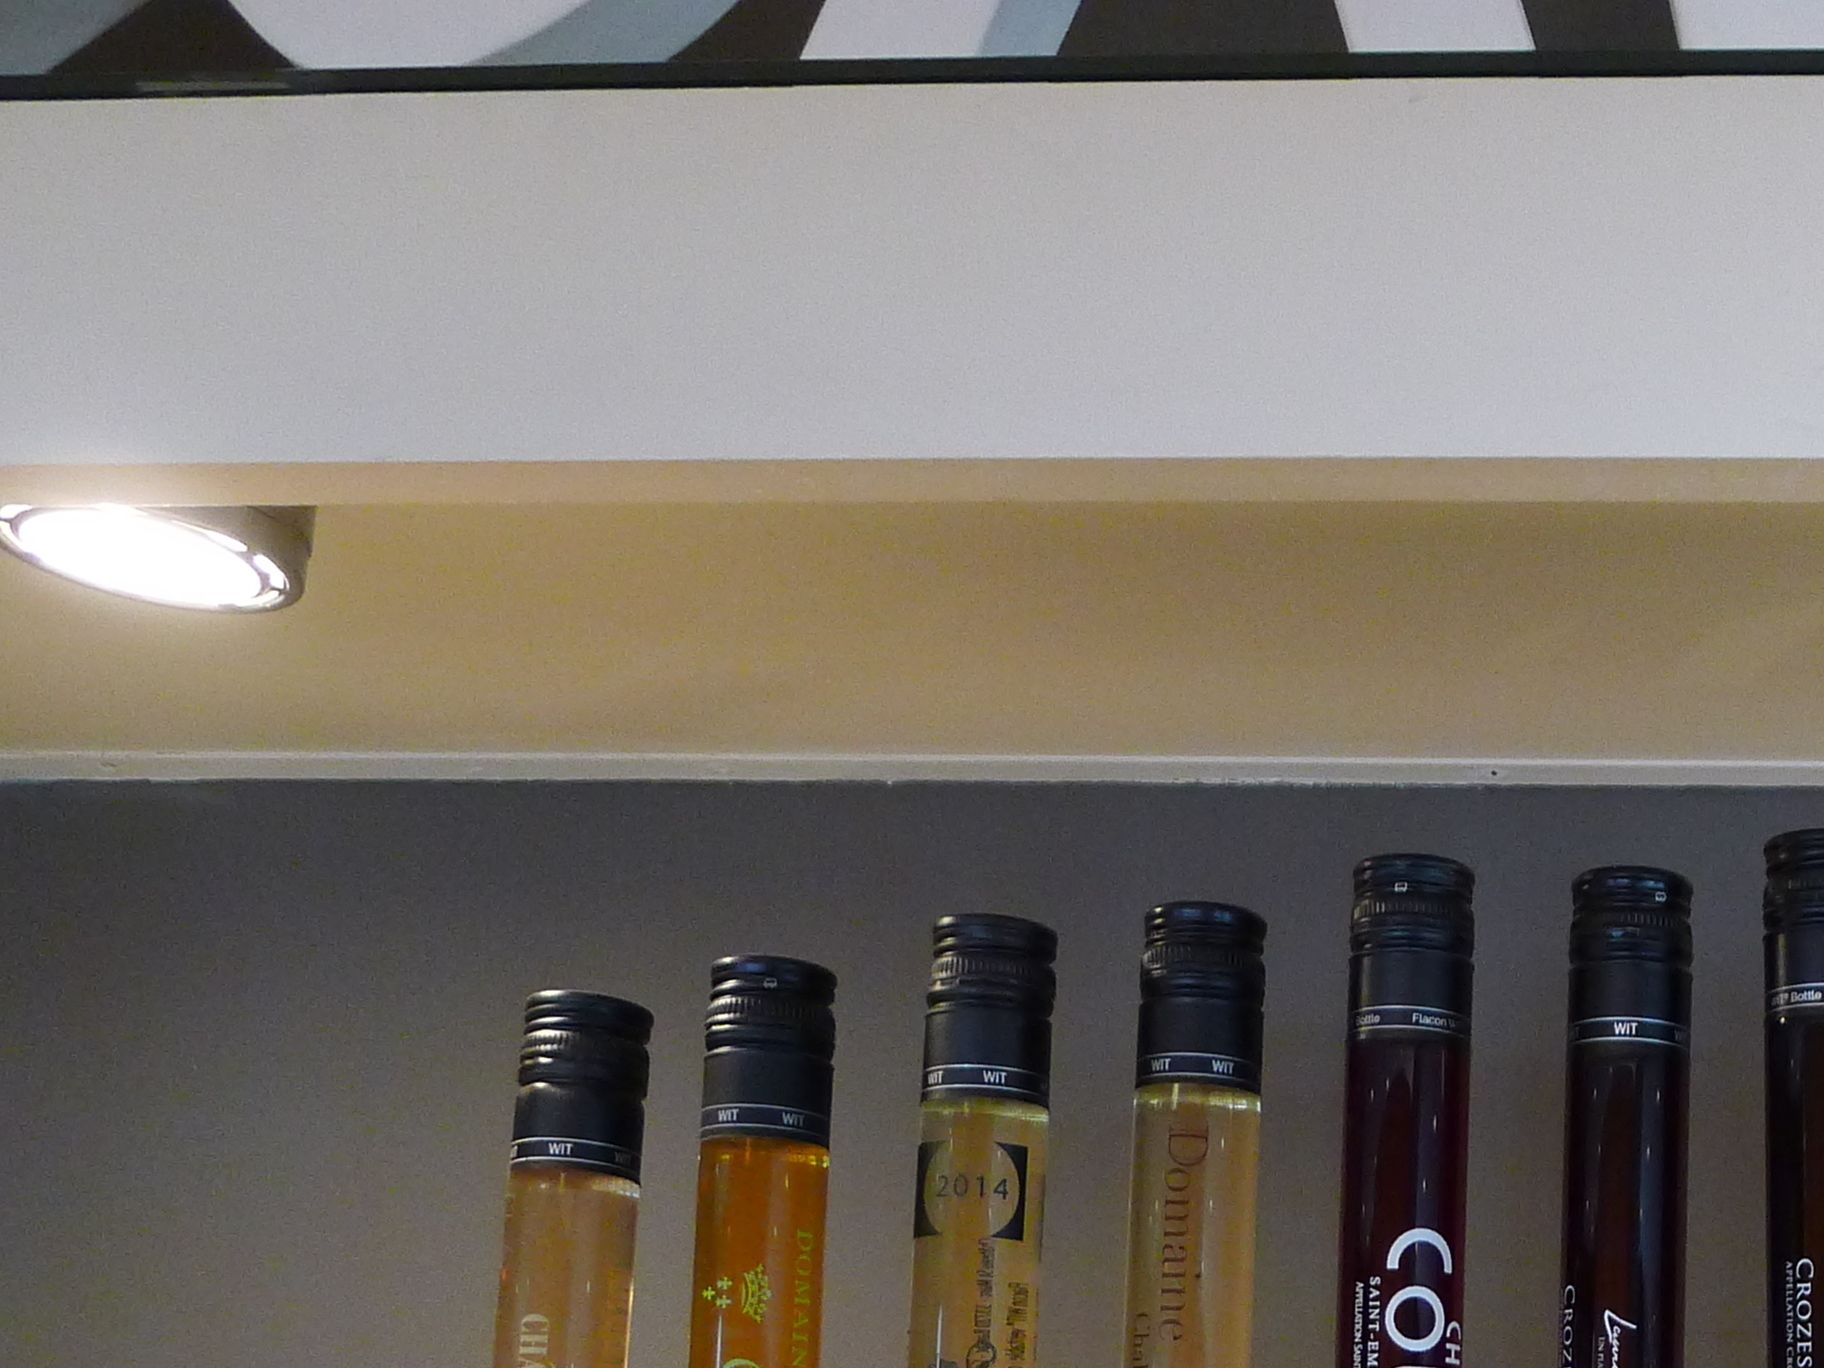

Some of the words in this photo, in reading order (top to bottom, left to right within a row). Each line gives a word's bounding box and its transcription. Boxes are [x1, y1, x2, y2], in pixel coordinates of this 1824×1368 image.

[1412, 1012, 1448, 1027] Flacon
[1614, 1022, 1638, 1036] WIT
[1151, 1058, 1171, 1071] WIT
[1212, 1060, 1234, 1074] WIT
[983, 1070, 1007, 1084] WIT
[718, 1108, 739, 1121] WIT
[782, 1111, 806, 1126] WIT
[549, 1142, 574, 1155] WIT
[936, 1174, 1008, 1200] 2014
[1158, 1123, 1209, 1342] Domaine
[1784, 1261, 1794, 1343] APPELLATION
[1352, 1281, 1365, 1344] APPELLATION
